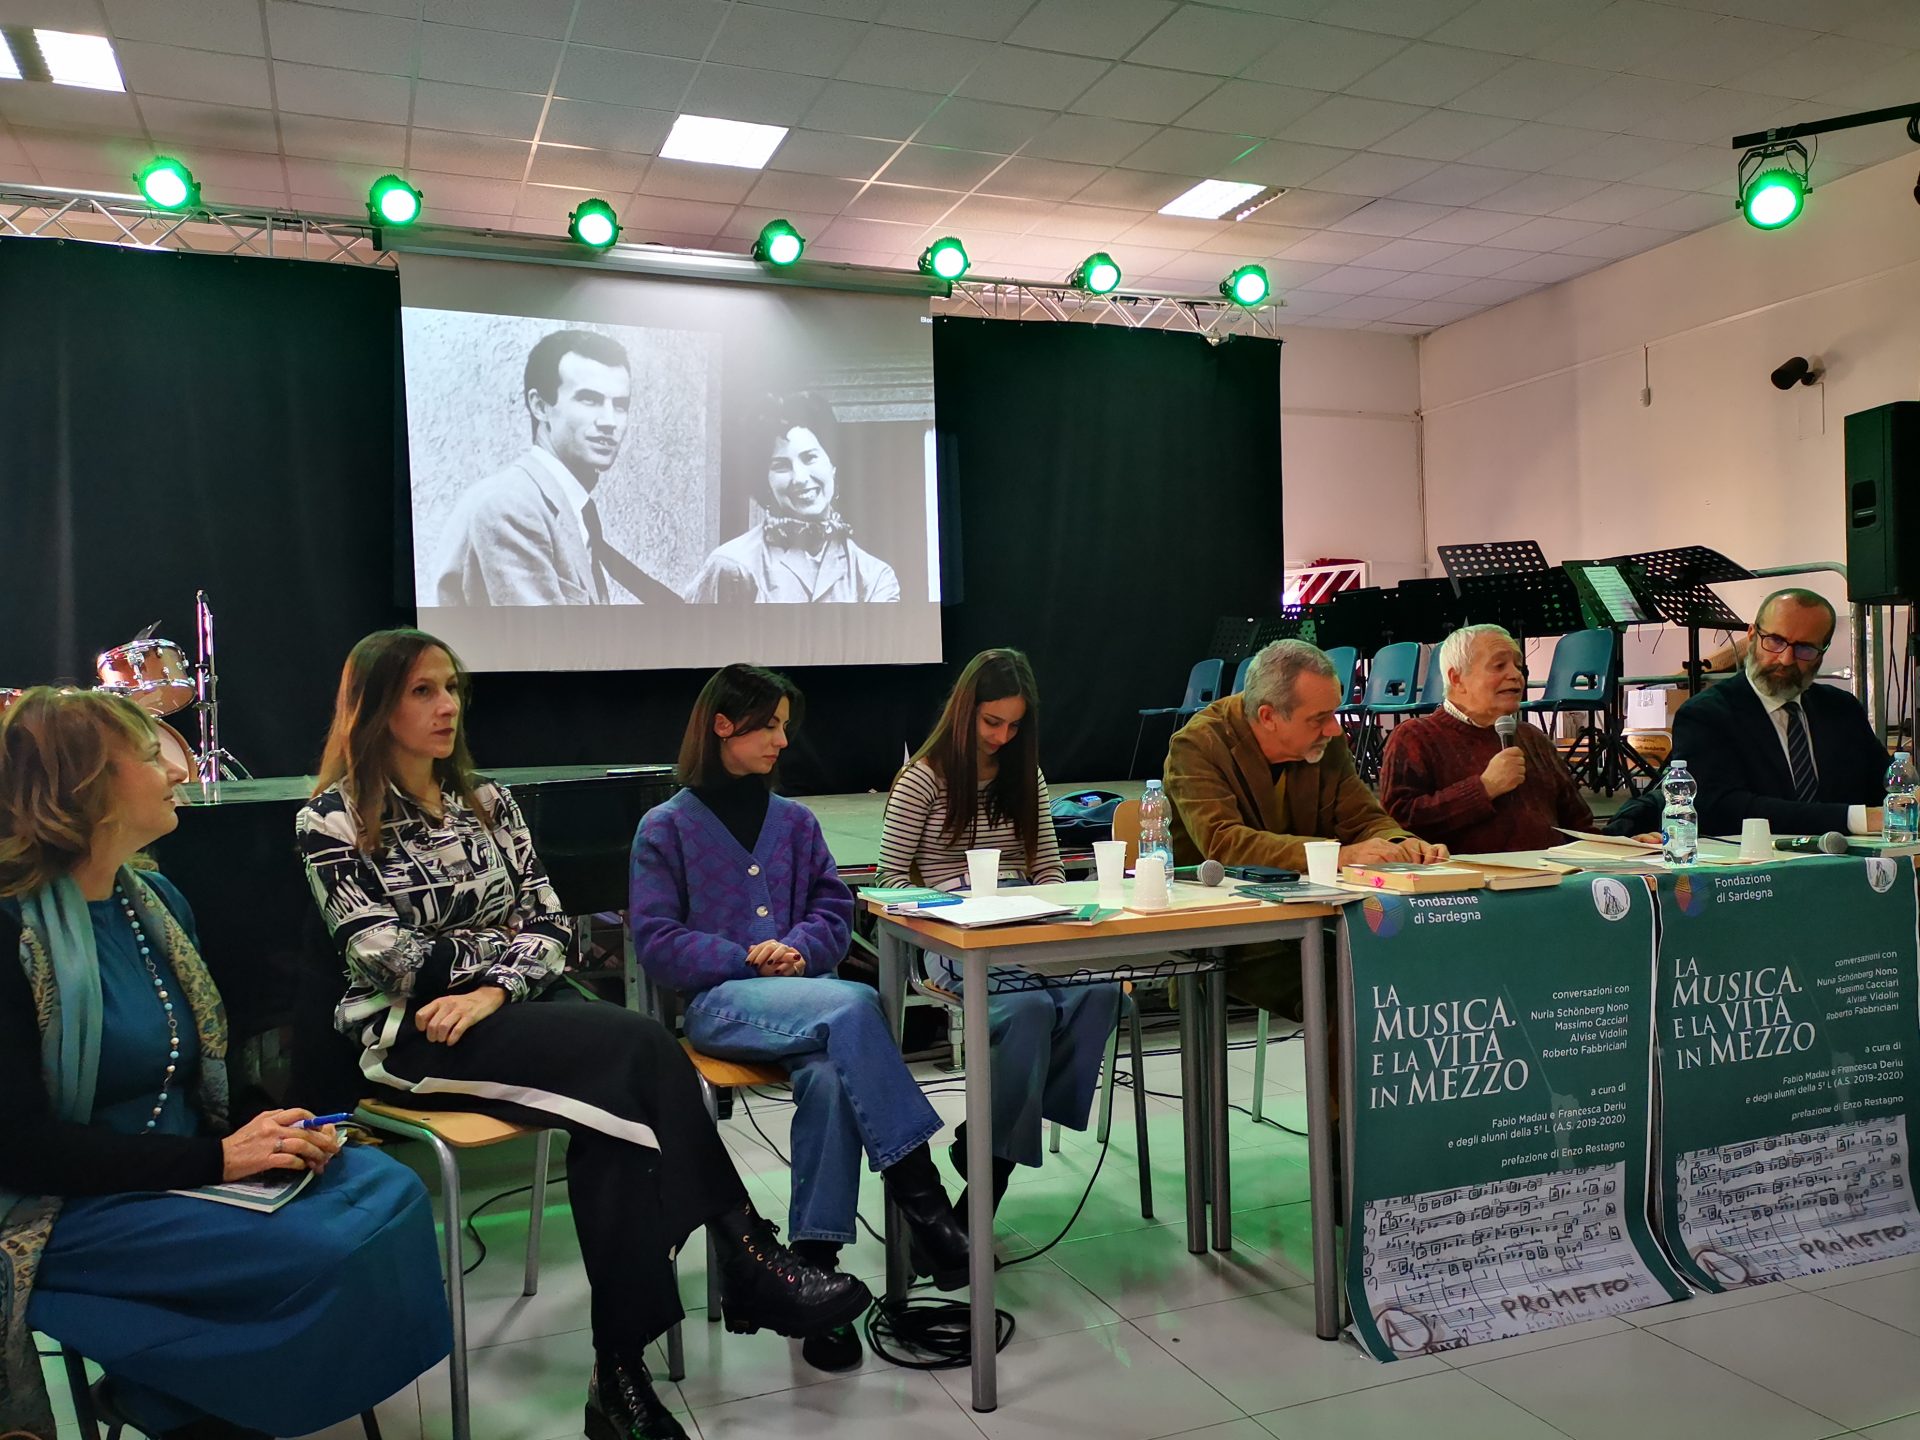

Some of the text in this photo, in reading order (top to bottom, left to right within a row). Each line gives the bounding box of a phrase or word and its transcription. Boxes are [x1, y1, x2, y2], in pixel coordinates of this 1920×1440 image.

[1714, 874, 1772, 888] Fondazione
[1408, 895, 1478, 908] Fondazione
[1716, 889, 1773, 903] di Sardegna
[1414, 911, 1481, 924] di Sardegna
[1675, 957, 1700, 978] LA
[1875, 968, 1898, 976] Nono
[1372, 984, 1401, 1009] LA
[1552, 985, 1630, 999] conversazioni con
[1672, 965, 1803, 1008] MUSICA.
[1835, 979, 1899, 995] Massimo Cacciari
[1846, 991, 1899, 1004] Alvise Vidolin
[1372, 996, 1516, 1043] MUSICA.
[1530, 1003, 1629, 1020] Nuria Schönberg Nono
[1672, 996, 1793, 1039] E LA VITA
[1826, 1003, 1899, 1020] Roberto Fabbriciani
[1555, 1015, 1628, 1031] Massimo Cacciari
[1570, 1029, 1627, 1042] Alvise Vidolin
[1677, 1022, 1816, 1070] IN MEZZO
[1893, 1042, 1901, 1050] di
[1372, 1030, 1505, 1076] E LA VITA
[1542, 1040, 1627, 1058] Roberto Fabbriciani
[1782, 1076, 1803, 1085] Fabio
[1805, 1070, 1829, 1080] Madau
[1837, 1062, 1877, 1074] Francesca
[1880, 1059, 1903, 1069] Deriu
[1798, 1084, 1816, 1094] della
[1854, 1071, 1903, 1084] 2019-2020)
[1369, 1059, 1529, 1109] IN MEZZO
[1590, 1082, 1626, 1096] a cura di
[1492, 1118, 1516, 1128] Fabio
[1519, 1113, 1547, 1124] Madau
[1558, 1105, 1601, 1118] Francesca
[1603, 1101, 1626, 1112] Deriu
[1791, 1095, 1904, 1121] prefazione di Enzo Restagno
[1456, 1136, 1479, 1147] degli
[1481, 1131, 1508, 1142] alunni
[1510, 1128, 1532, 1138] della
[1544, 1124, 1550, 1133] L
[1577, 1113, 1626, 1129] 2019-2020)
[1502, 1140, 1626, 1168] prefazione di Enzo Restagno
[1800, 1225, 1908, 1260] PROMETEO
[1501, 1279, 1629, 1320] PROMETEO
